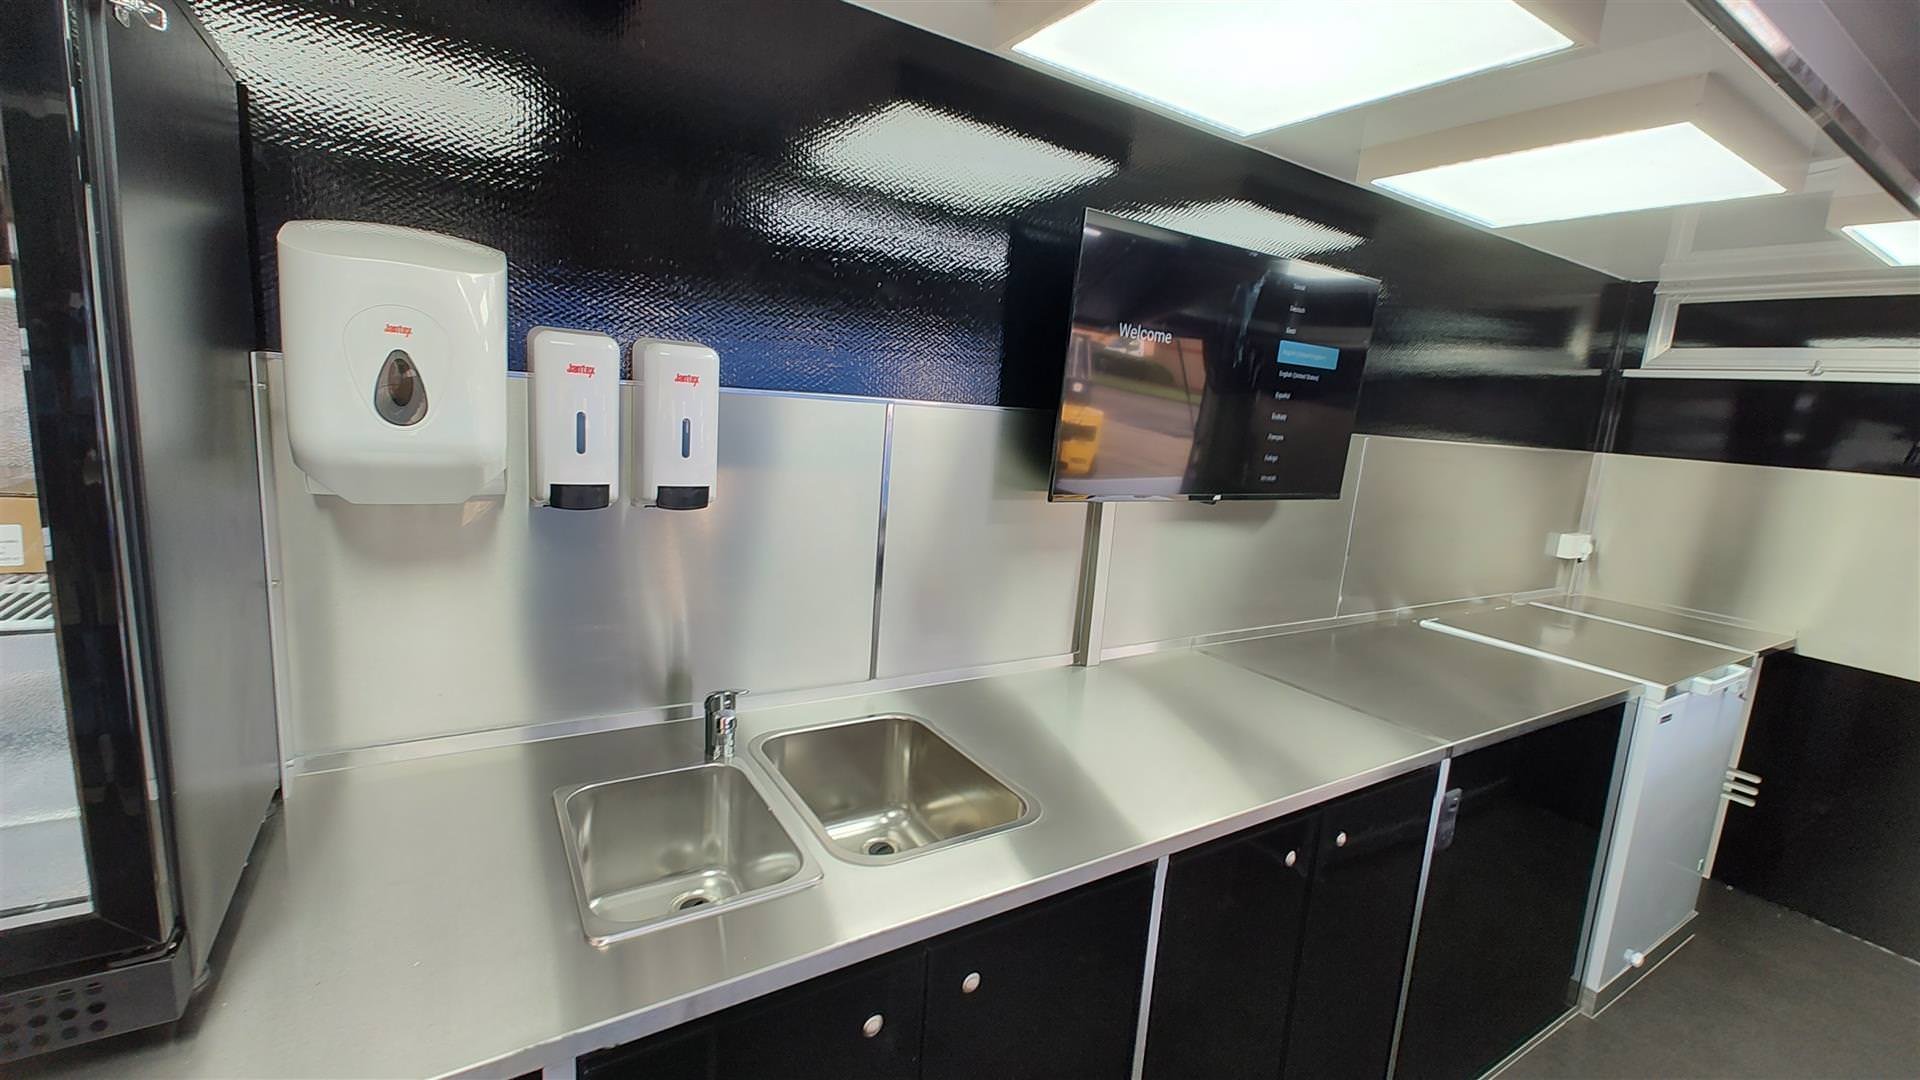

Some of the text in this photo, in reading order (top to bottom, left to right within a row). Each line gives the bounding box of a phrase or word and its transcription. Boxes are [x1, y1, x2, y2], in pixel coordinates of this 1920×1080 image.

[1119, 322, 1172, 344] Welcome
[567, 362, 595, 378] Jantex
[675, 372, 700, 387] Jantex
